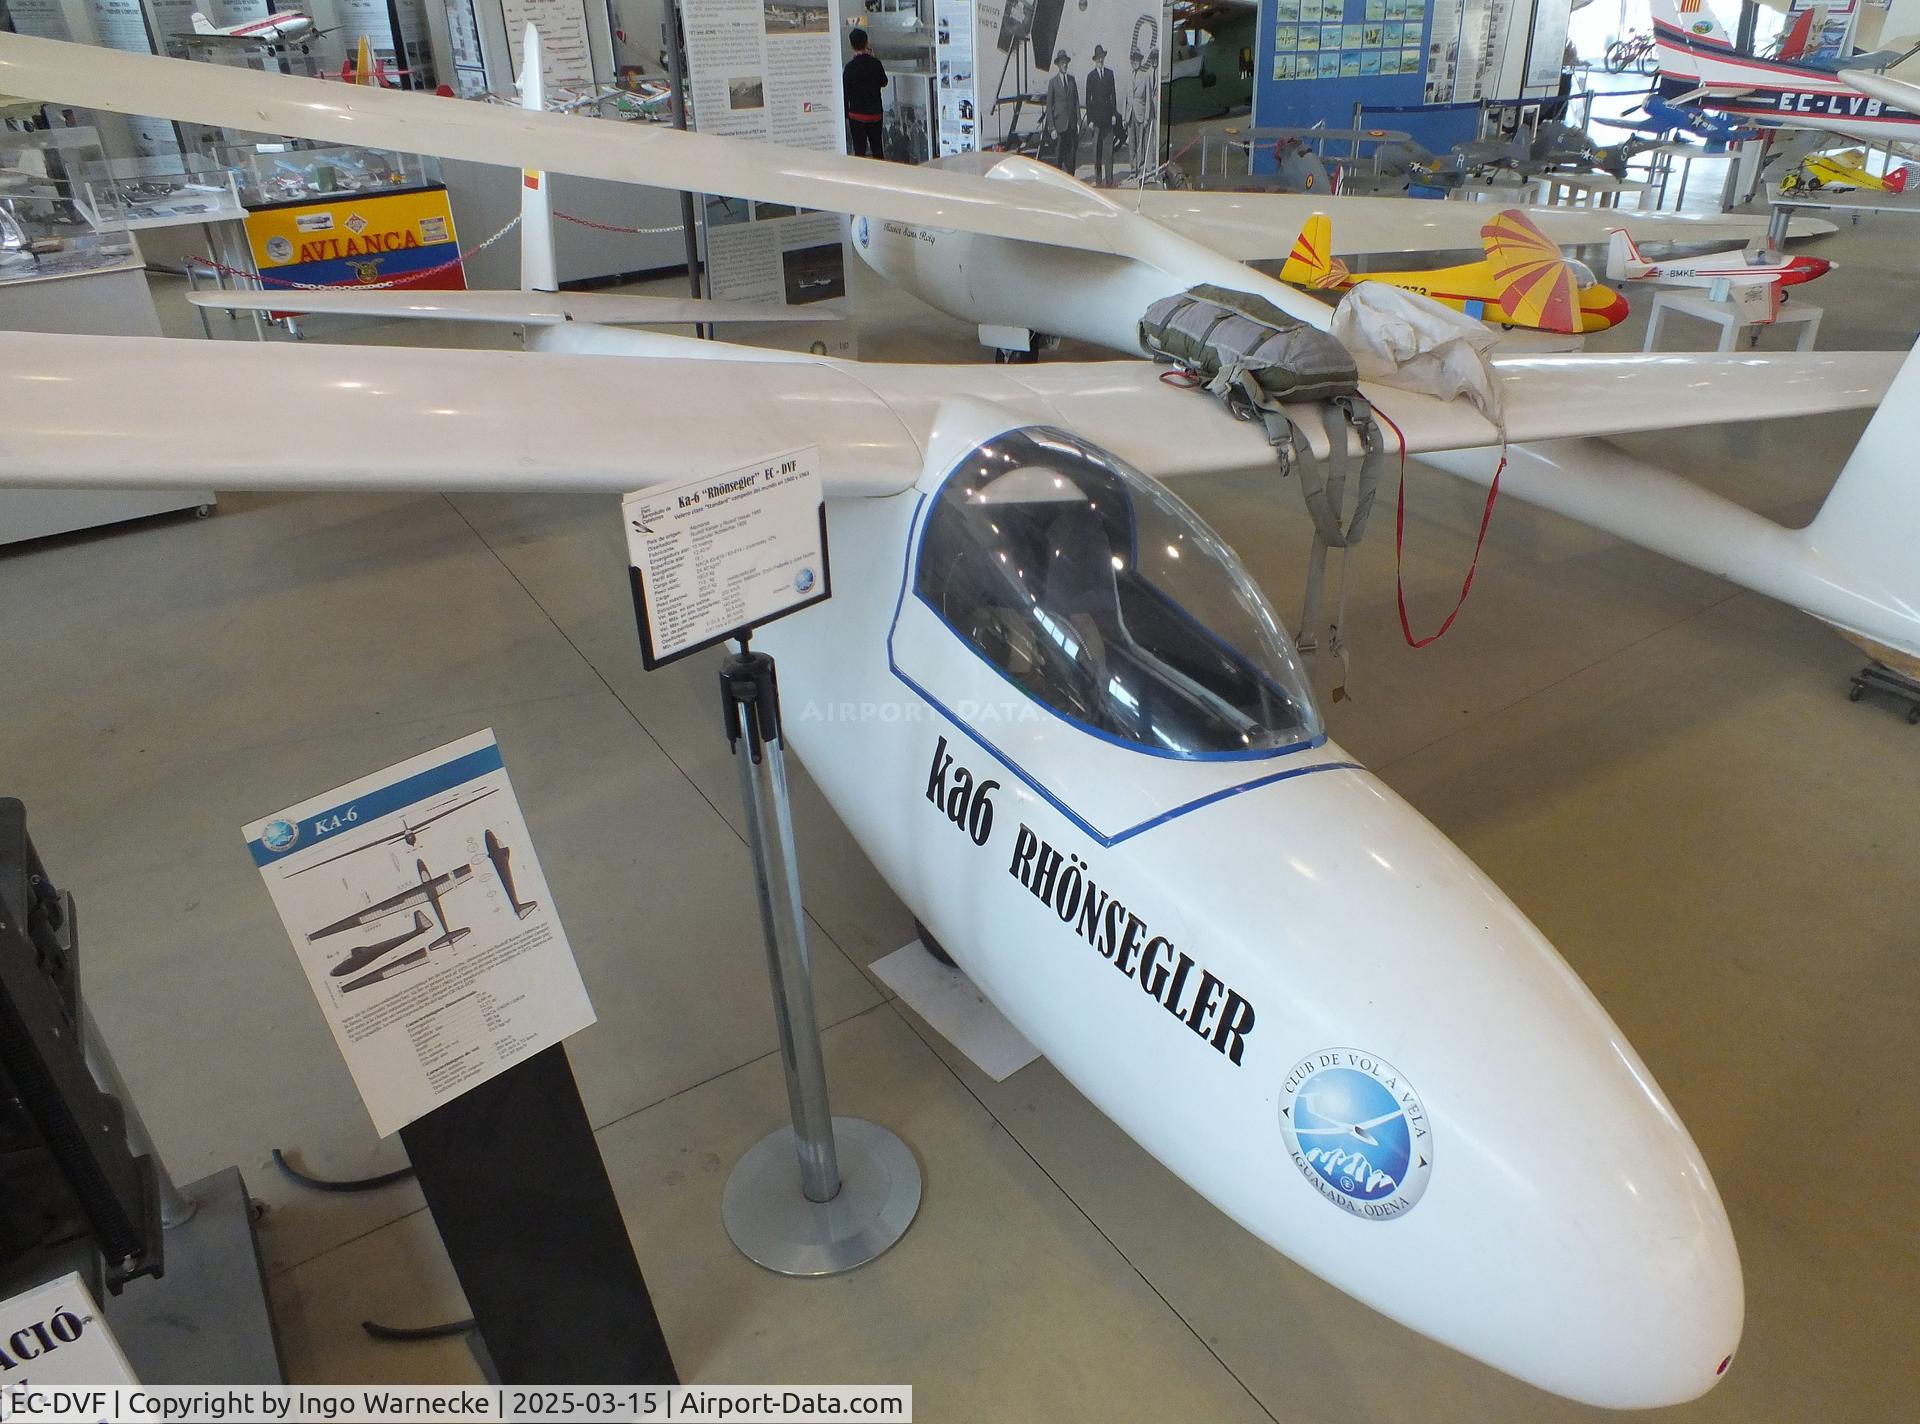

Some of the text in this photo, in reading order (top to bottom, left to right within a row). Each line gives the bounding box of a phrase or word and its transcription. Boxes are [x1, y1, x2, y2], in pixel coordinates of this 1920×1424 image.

[1778, 92, 1882, 117] EC-LVB
[1456, 153, 1465, 169] R
[299, 229, 419, 263] AVIANCA
[678, 492, 699, 508] Ka-6
[765, 468, 773, 480] EC
[782, 461, 796, 474] DVF
[925, 735, 1001, 847] ka6
[313, 805, 358, 837] KA-6
[1008, 822, 1256, 1068] RHÖNSEGLER
[1285, 1061, 1315, 1094] CLUB
[1319, 1053, 1340, 1067] DE
[1347, 1054, 1380, 1076] VOL
[1401, 1092, 1428, 1139] VELA
